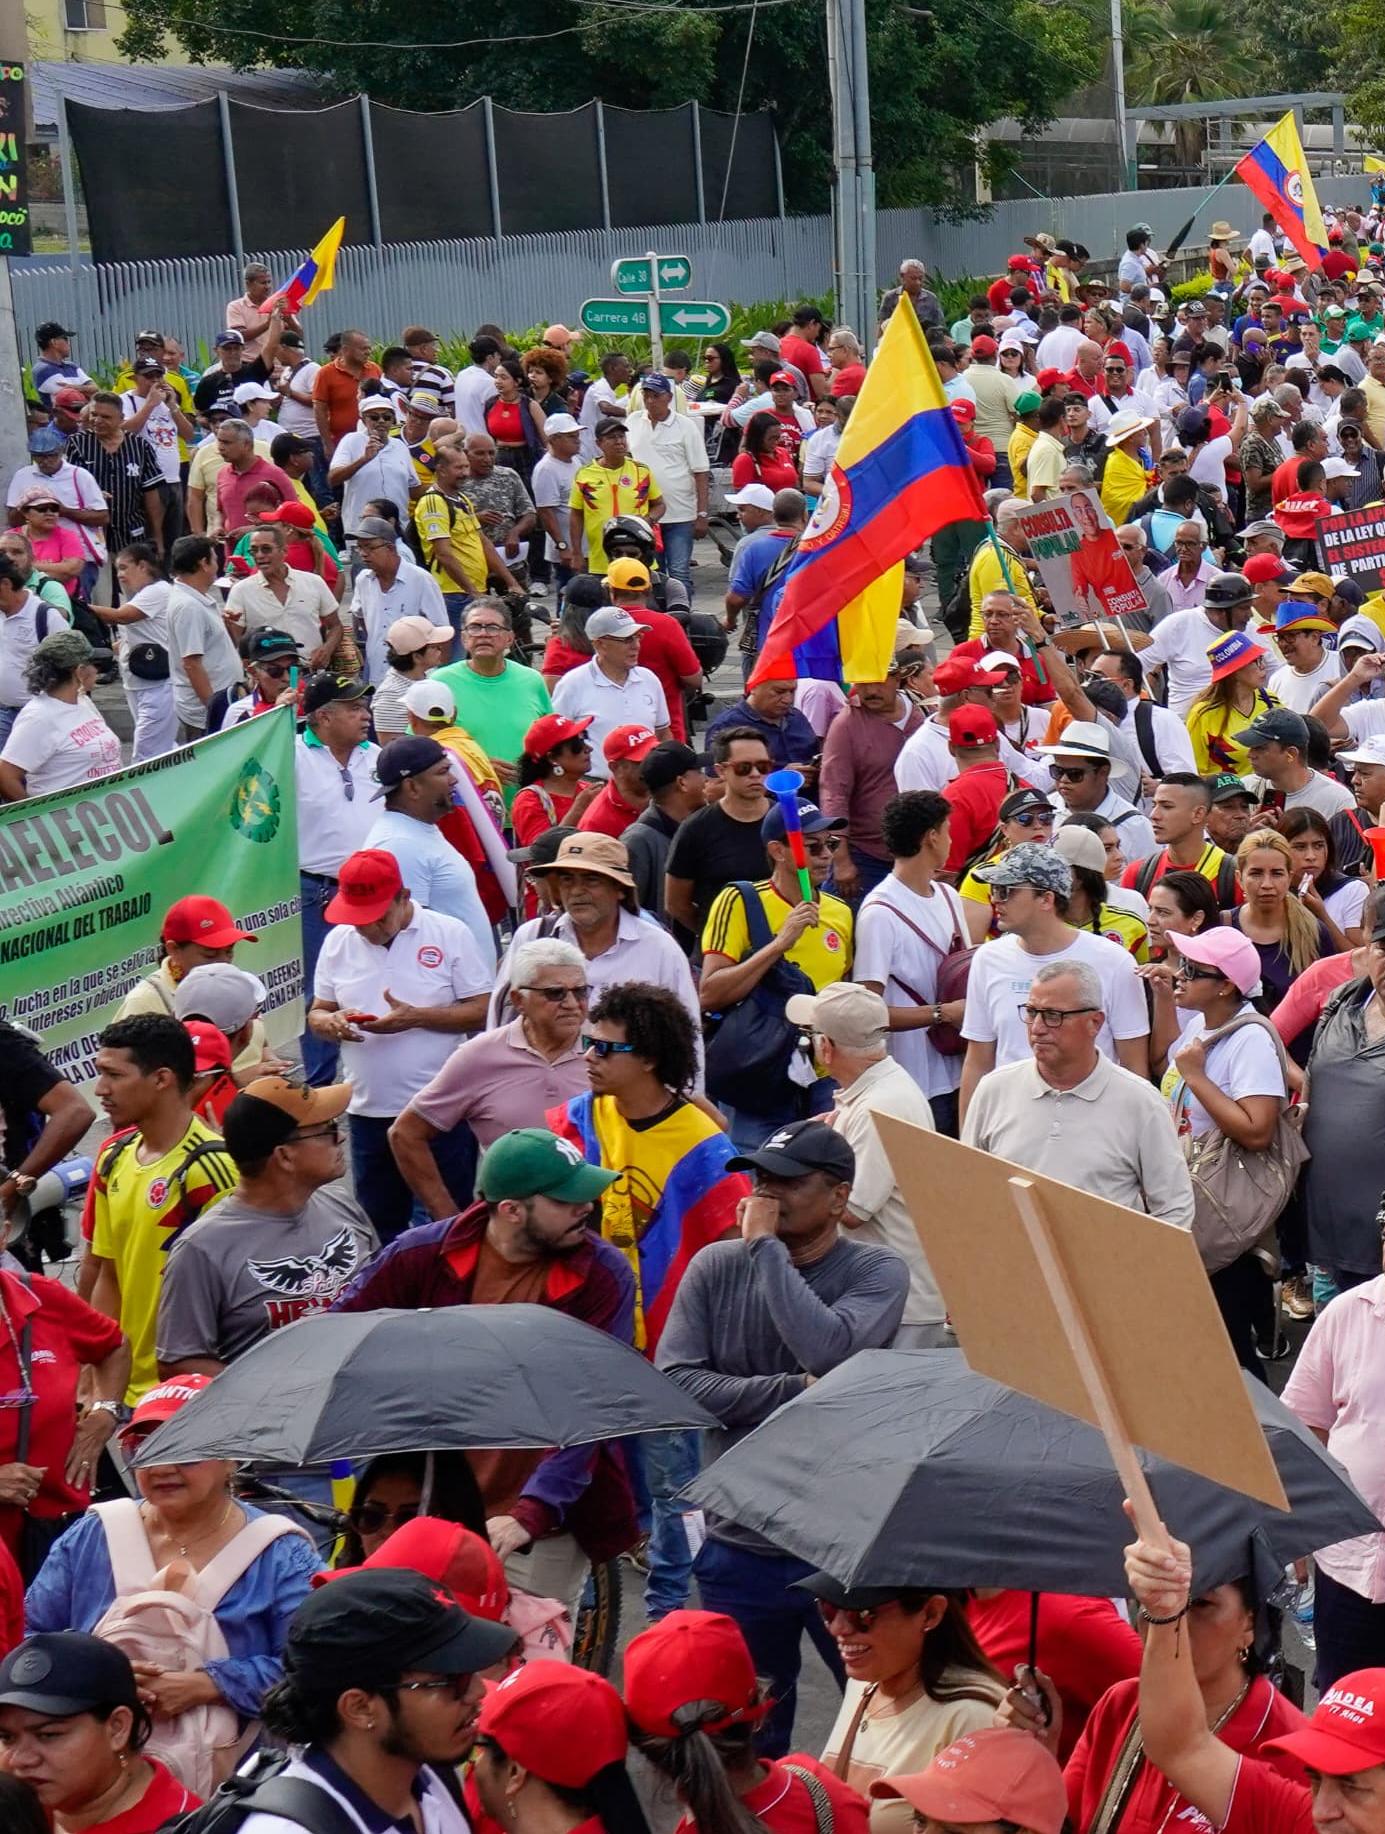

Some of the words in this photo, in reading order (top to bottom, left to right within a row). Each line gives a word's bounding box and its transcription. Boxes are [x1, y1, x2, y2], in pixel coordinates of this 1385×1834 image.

[618, 271, 635, 283] Calle
[639, 270, 647, 282] 30
[586, 310, 628, 324] Carrera
[1020, 507, 1074, 539] CONSULTA
[1321, 516, 1347, 532] POR
[1350, 512, 1365, 527] LA
[1030, 530, 1082, 562] POPULAR
[1323, 533, 1340, 547] DE
[1341, 529, 1355, 543] LA
[1355, 525, 1374, 541] LEY
[1327, 549, 1342, 563] EL
[1330, 563, 1349, 577] DE
[1110, 597, 1145, 615] POPULAR
[1216, 640, 1245, 664] COLOMBIA
[55, 874, 125, 911] Atlántico
[0, 915, 71, 964] NACIONAL
[72, 909, 97, 942] DEL
[98, 892, 152, 928] TRABAJO
[245, 910, 268, 932] una
[269, 904, 290, 925] sola
[272, 958, 302, 990] DEFENSA
[13, 990, 51, 1017] lucha
[52, 984, 68, 1003] en
[69, 977, 81, 998] la
[82, 973, 105, 998] que
[106, 964, 120, 981] se
[27, 999, 91, 1033] intereses
